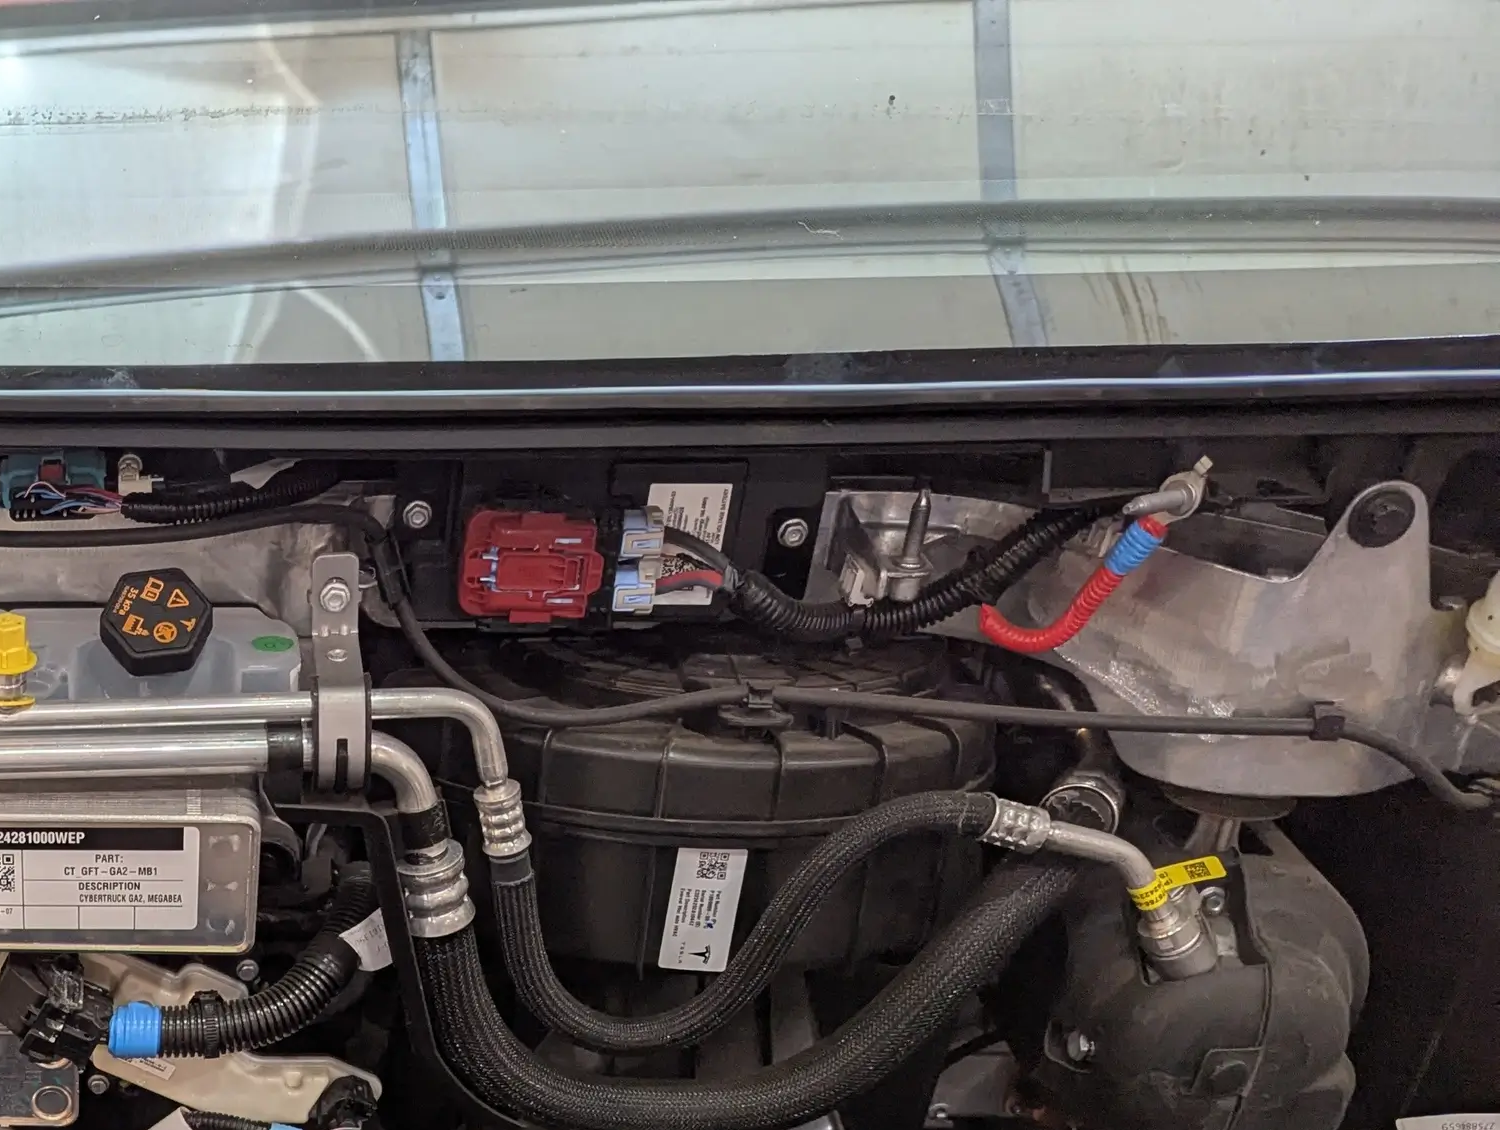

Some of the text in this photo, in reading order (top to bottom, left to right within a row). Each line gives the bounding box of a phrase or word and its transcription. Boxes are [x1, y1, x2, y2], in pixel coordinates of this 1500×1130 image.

[127, 587, 139, 600] 35
[118, 599, 133, 616] kPa
[95, 854, 123, 863] PART:
[78, 882, 141, 891] DESCRIPTION
[79, 894, 127, 903] CYBERTRUCK
[128, 894, 145, 904] GA2,
[678, 942, 686, 964] TESLA
